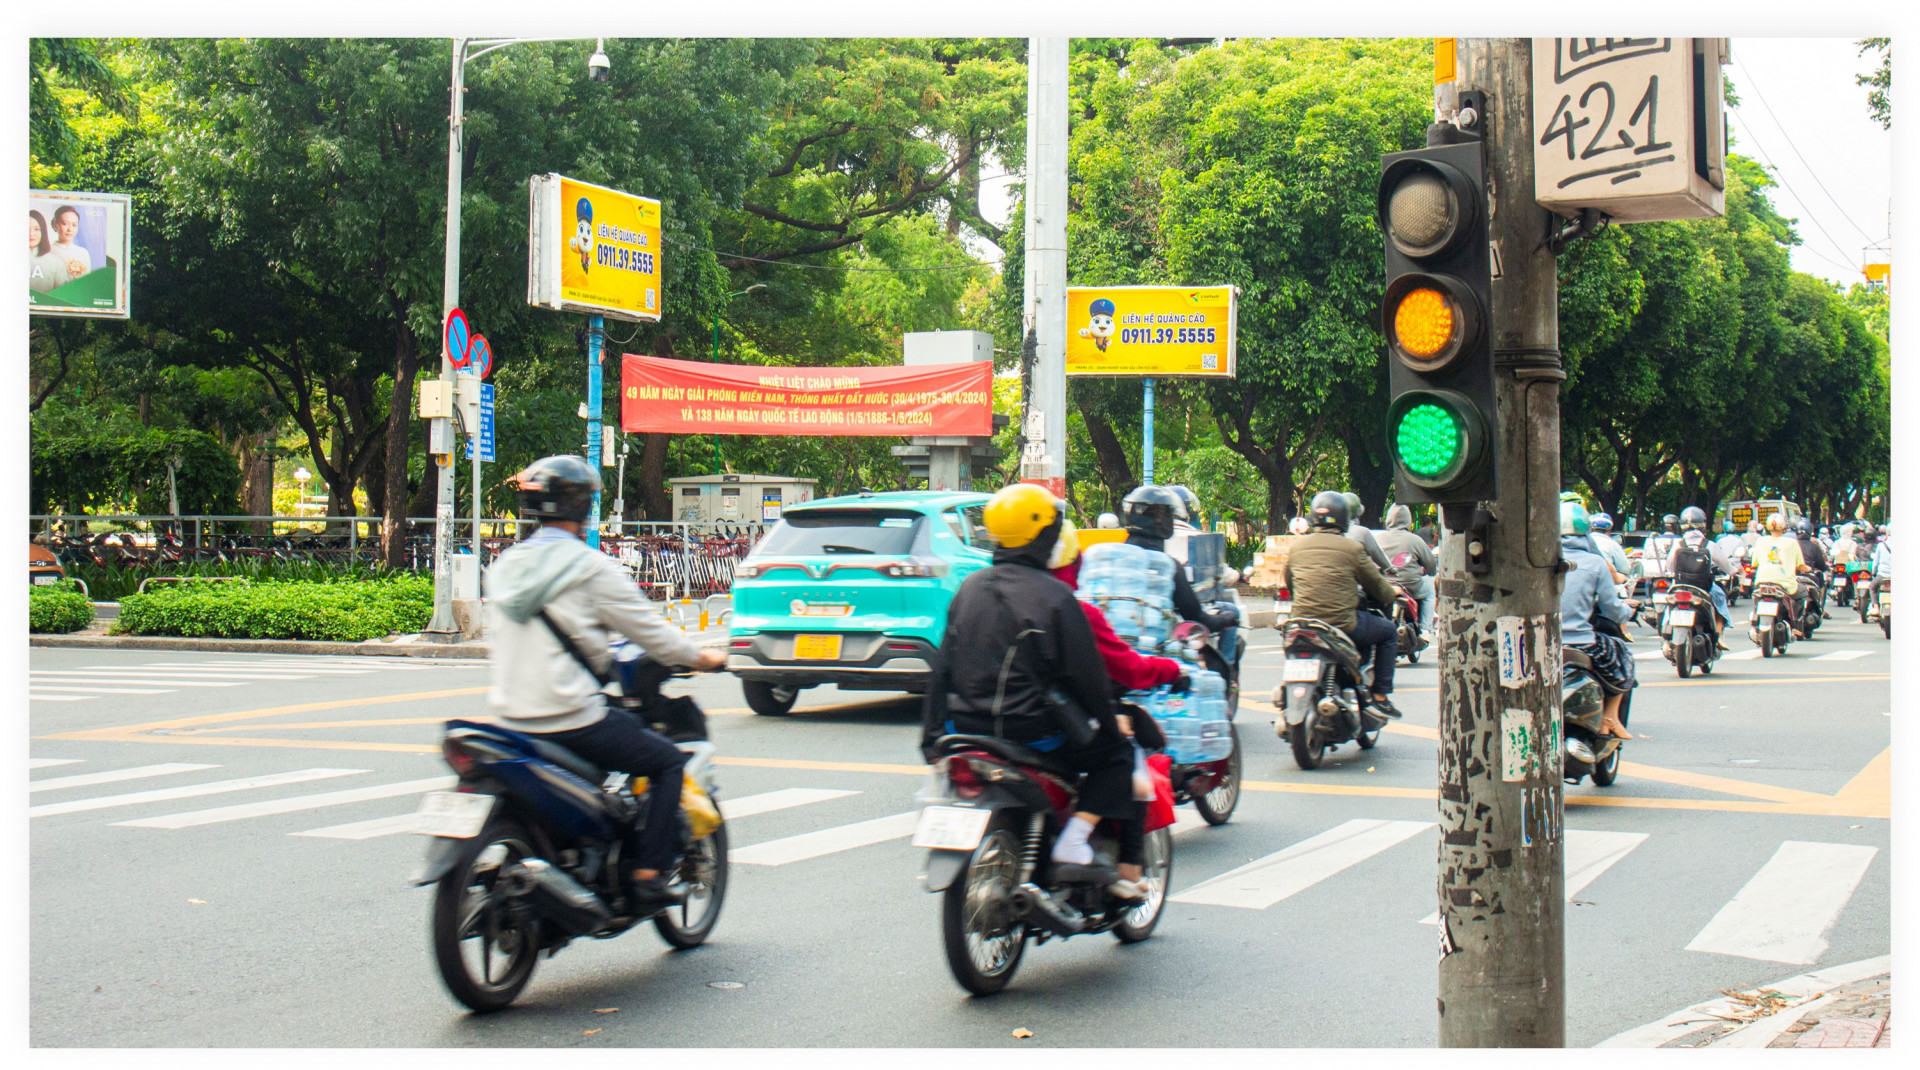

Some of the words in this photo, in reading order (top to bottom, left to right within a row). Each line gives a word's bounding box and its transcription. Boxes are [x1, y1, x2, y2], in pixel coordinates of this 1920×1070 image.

[598, 223, 609, 237] LIÊN
[611, 226, 617, 243] HỆ
[619, 228, 636, 244] QUẢNG
[638, 232, 647, 246] CÁO
[598, 243, 653, 274] 0911.39.5555
[1123, 313, 1140, 323] LIÊN
[1144, 312, 1154, 325] HỆ
[1157, 312, 1186, 323] QUẢNG
[1189, 312, 1205, 323] CÁO
[1122, 328, 1215, 344] 0911.39.5555
[759, 375, 784, 390] NHIỆT
[787, 376, 804, 391] LIỆT
[807, 376, 831, 389] CHÀO
[833, 375, 860, 389] MỪNG
[626, 387, 637, 399] 49
[640, 386, 659, 399] NĂM
[662, 386, 684, 400] NGÀY
[687, 386, 704, 401] GIẢI
[707, 387, 737, 402] PHÓNG
[739, 389, 762, 403] MIỀN
[764, 392, 787, 405] NAM,
[790, 390, 819, 404] THỐNG
[821, 390, 843, 404] NHẤT
[846, 390, 863, 404] ĐẤT
[864, 390, 889, 404] NƯỚC
[891, 392, 987, 406] (30/4/1975-30/4/2024)
[681, 407, 693, 421] VÀ
[696, 409, 712, 421] 138
[715, 407, 734, 422] NĂM
[737, 407, 759, 422] NGÀY
[762, 407, 785, 424] QUỐC
[788, 407, 798, 423] TẾ
[801, 411, 817, 423] LAO
[820, 409, 844, 427] ĐỘNG
[846, 411, 933, 426] (1/5/1886-1/5/2024)
